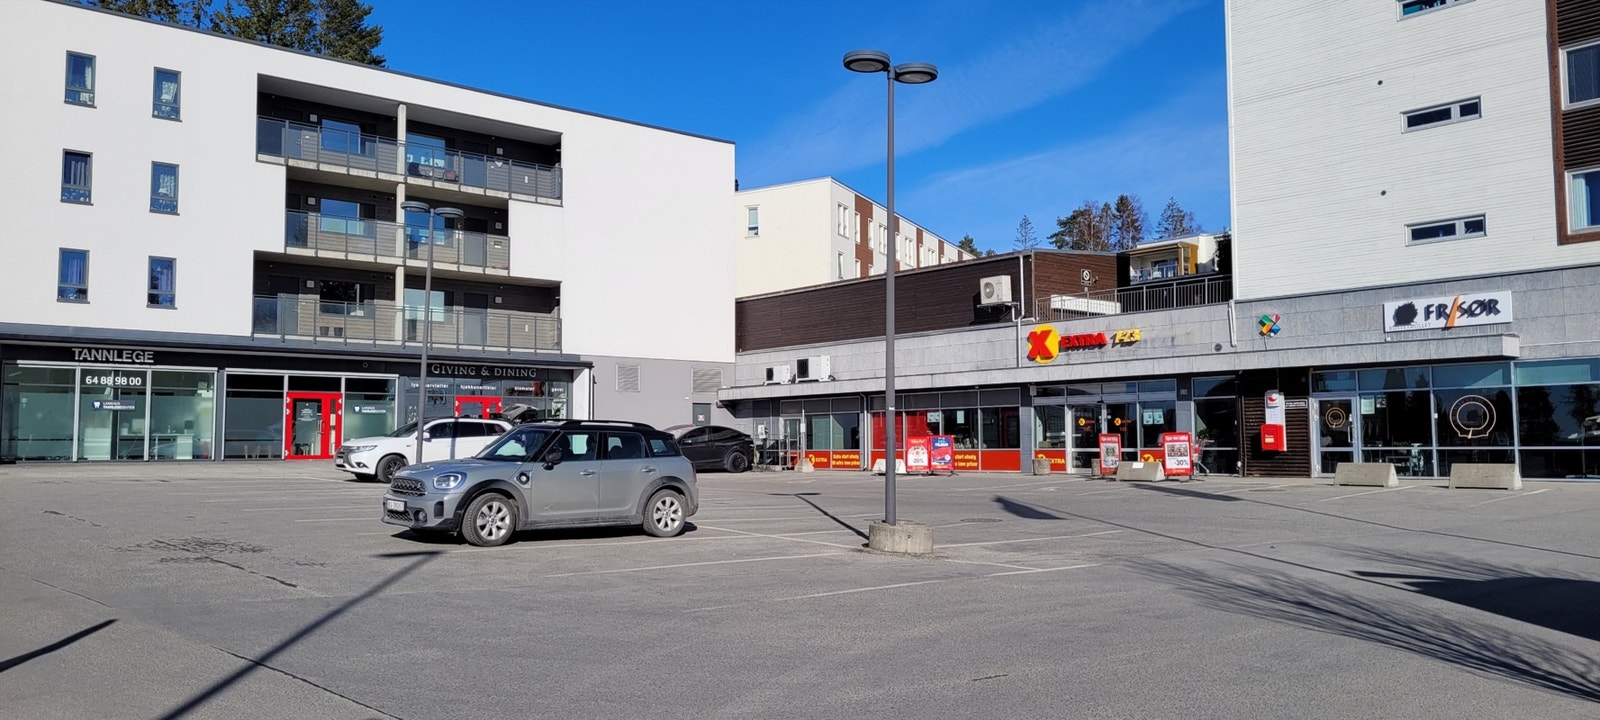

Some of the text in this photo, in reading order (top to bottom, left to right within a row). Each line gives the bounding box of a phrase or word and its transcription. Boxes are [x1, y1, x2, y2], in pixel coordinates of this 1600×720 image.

[1060, 332, 1108, 348] EXTRA
[72, 348, 154, 363] TANNLEGE
[431, 364, 537, 377] GIVING & DINING
[85, 376, 142, 385] 64 88 98 00
